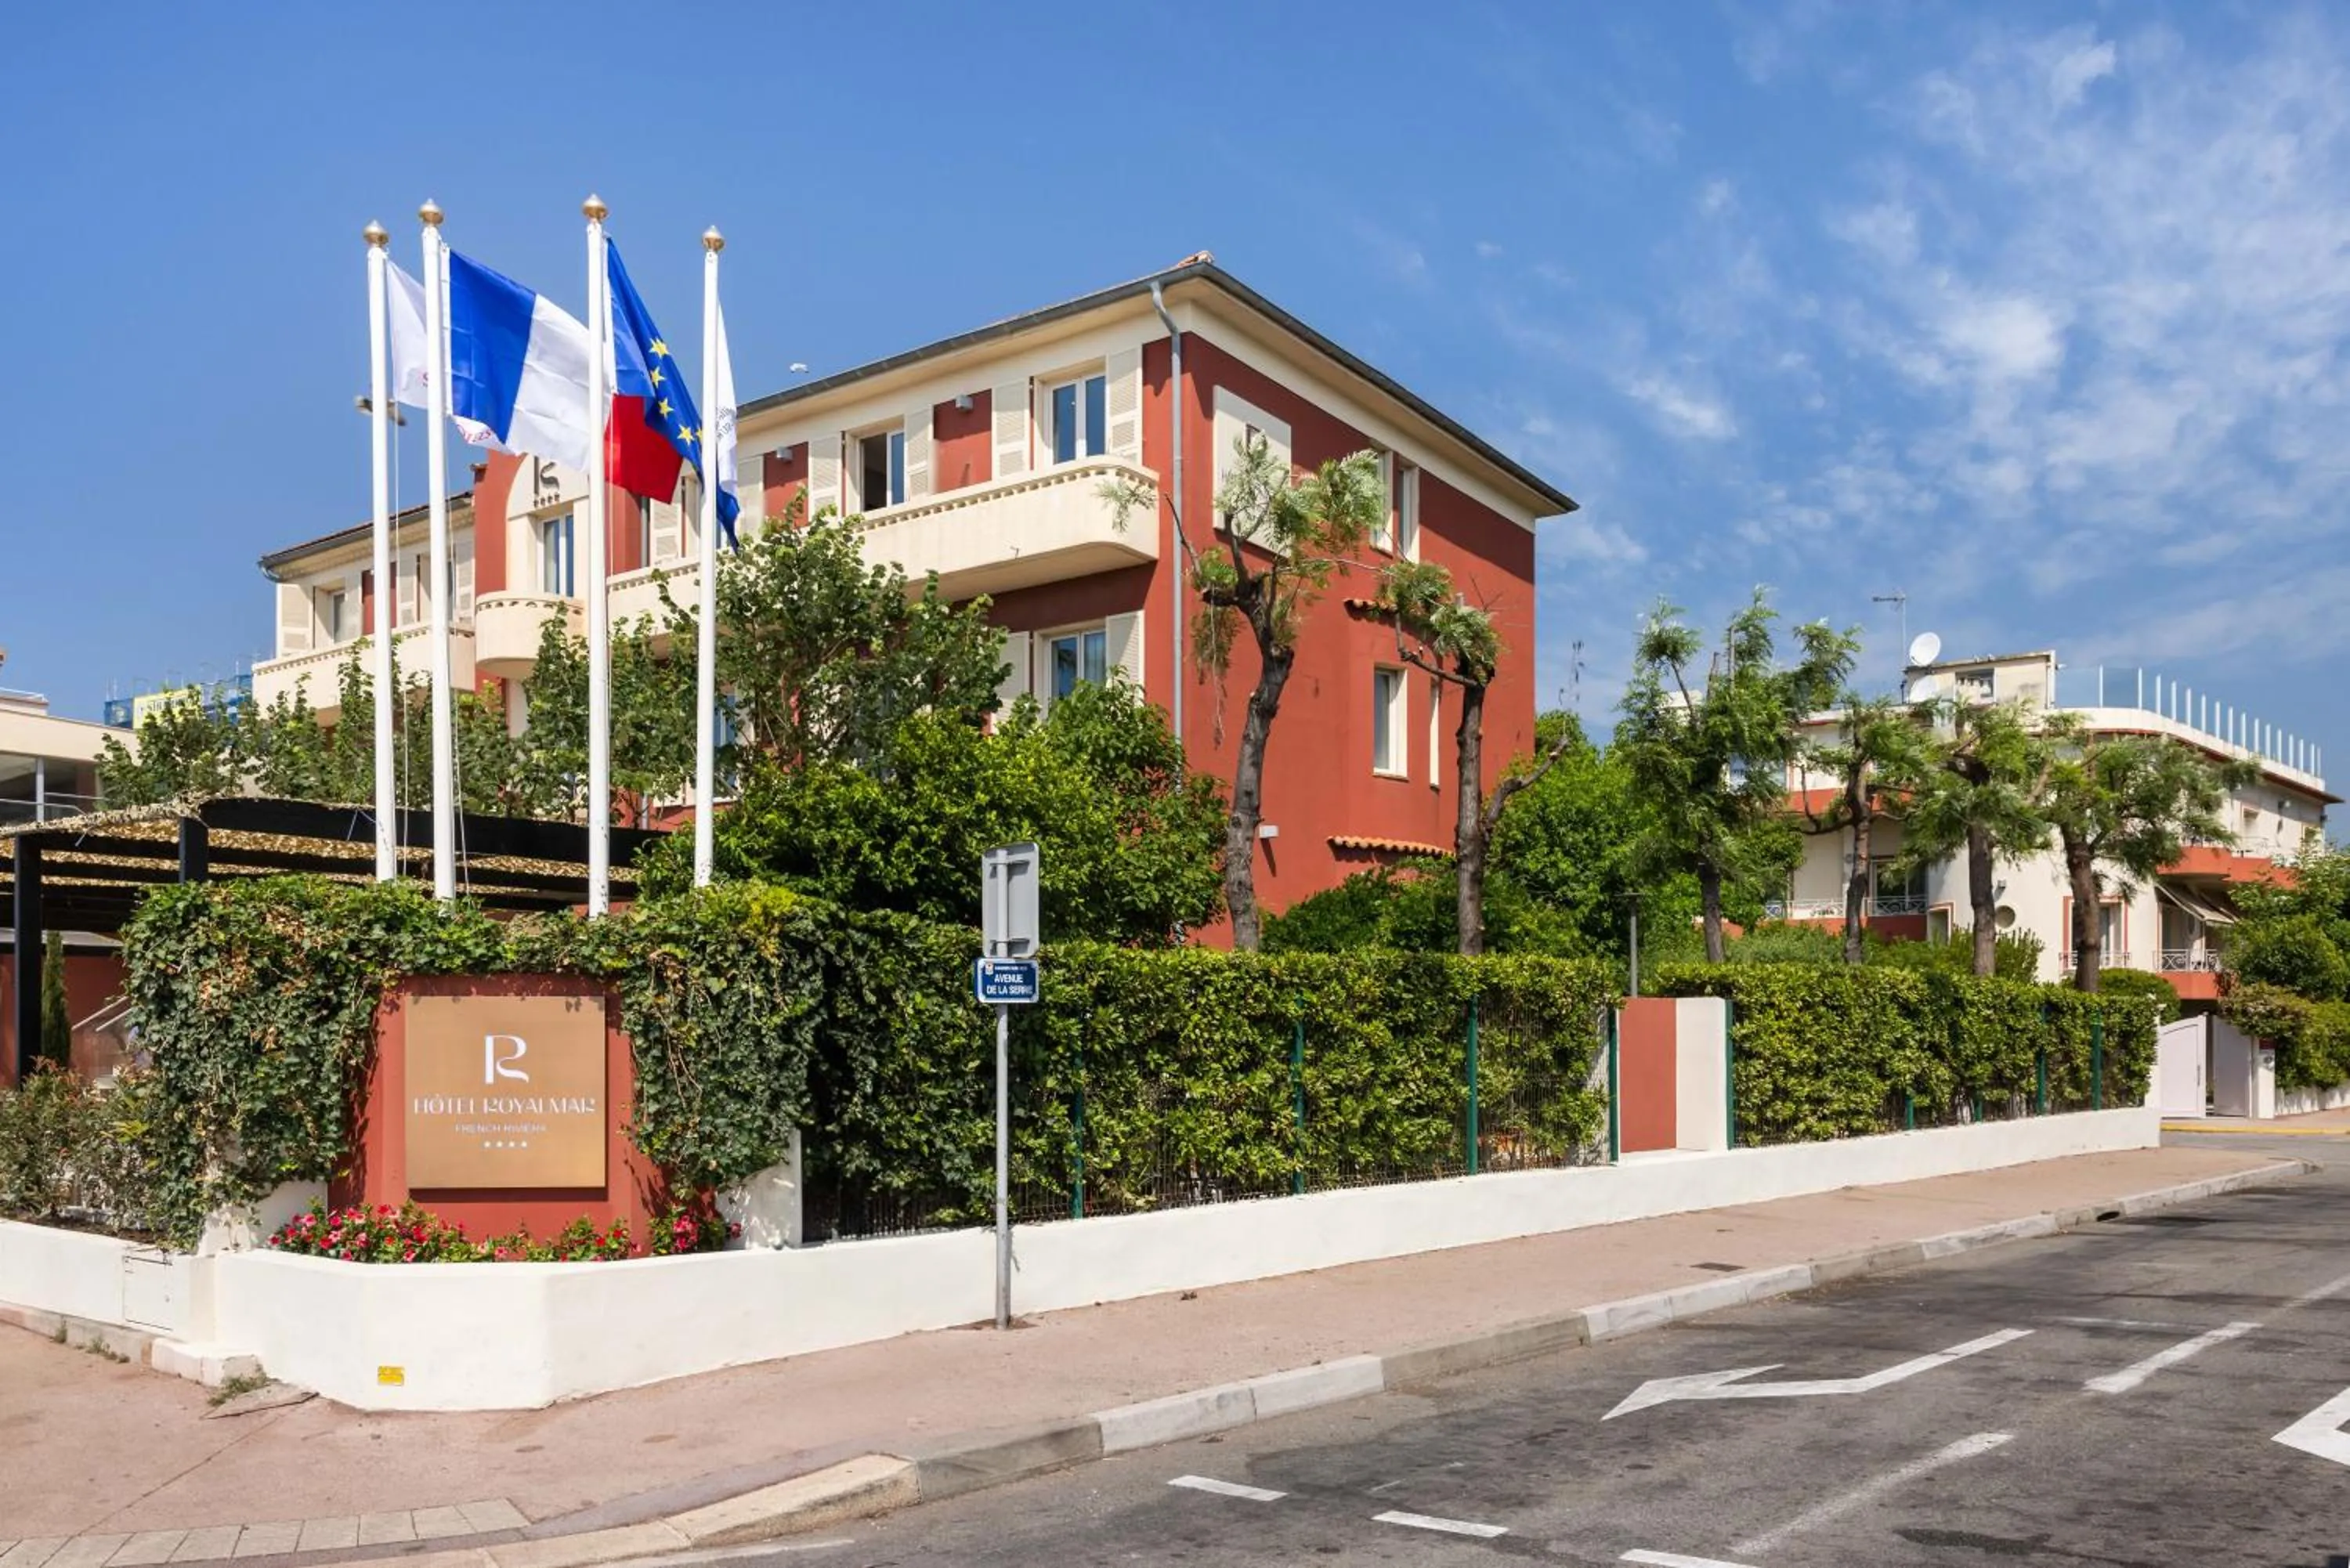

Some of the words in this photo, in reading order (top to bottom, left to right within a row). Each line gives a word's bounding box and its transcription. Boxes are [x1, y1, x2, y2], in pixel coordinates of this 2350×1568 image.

[994, 974, 1024, 983] AVENUE
[986, 985, 997, 994] DE
[998, 985, 1008, 995] LA
